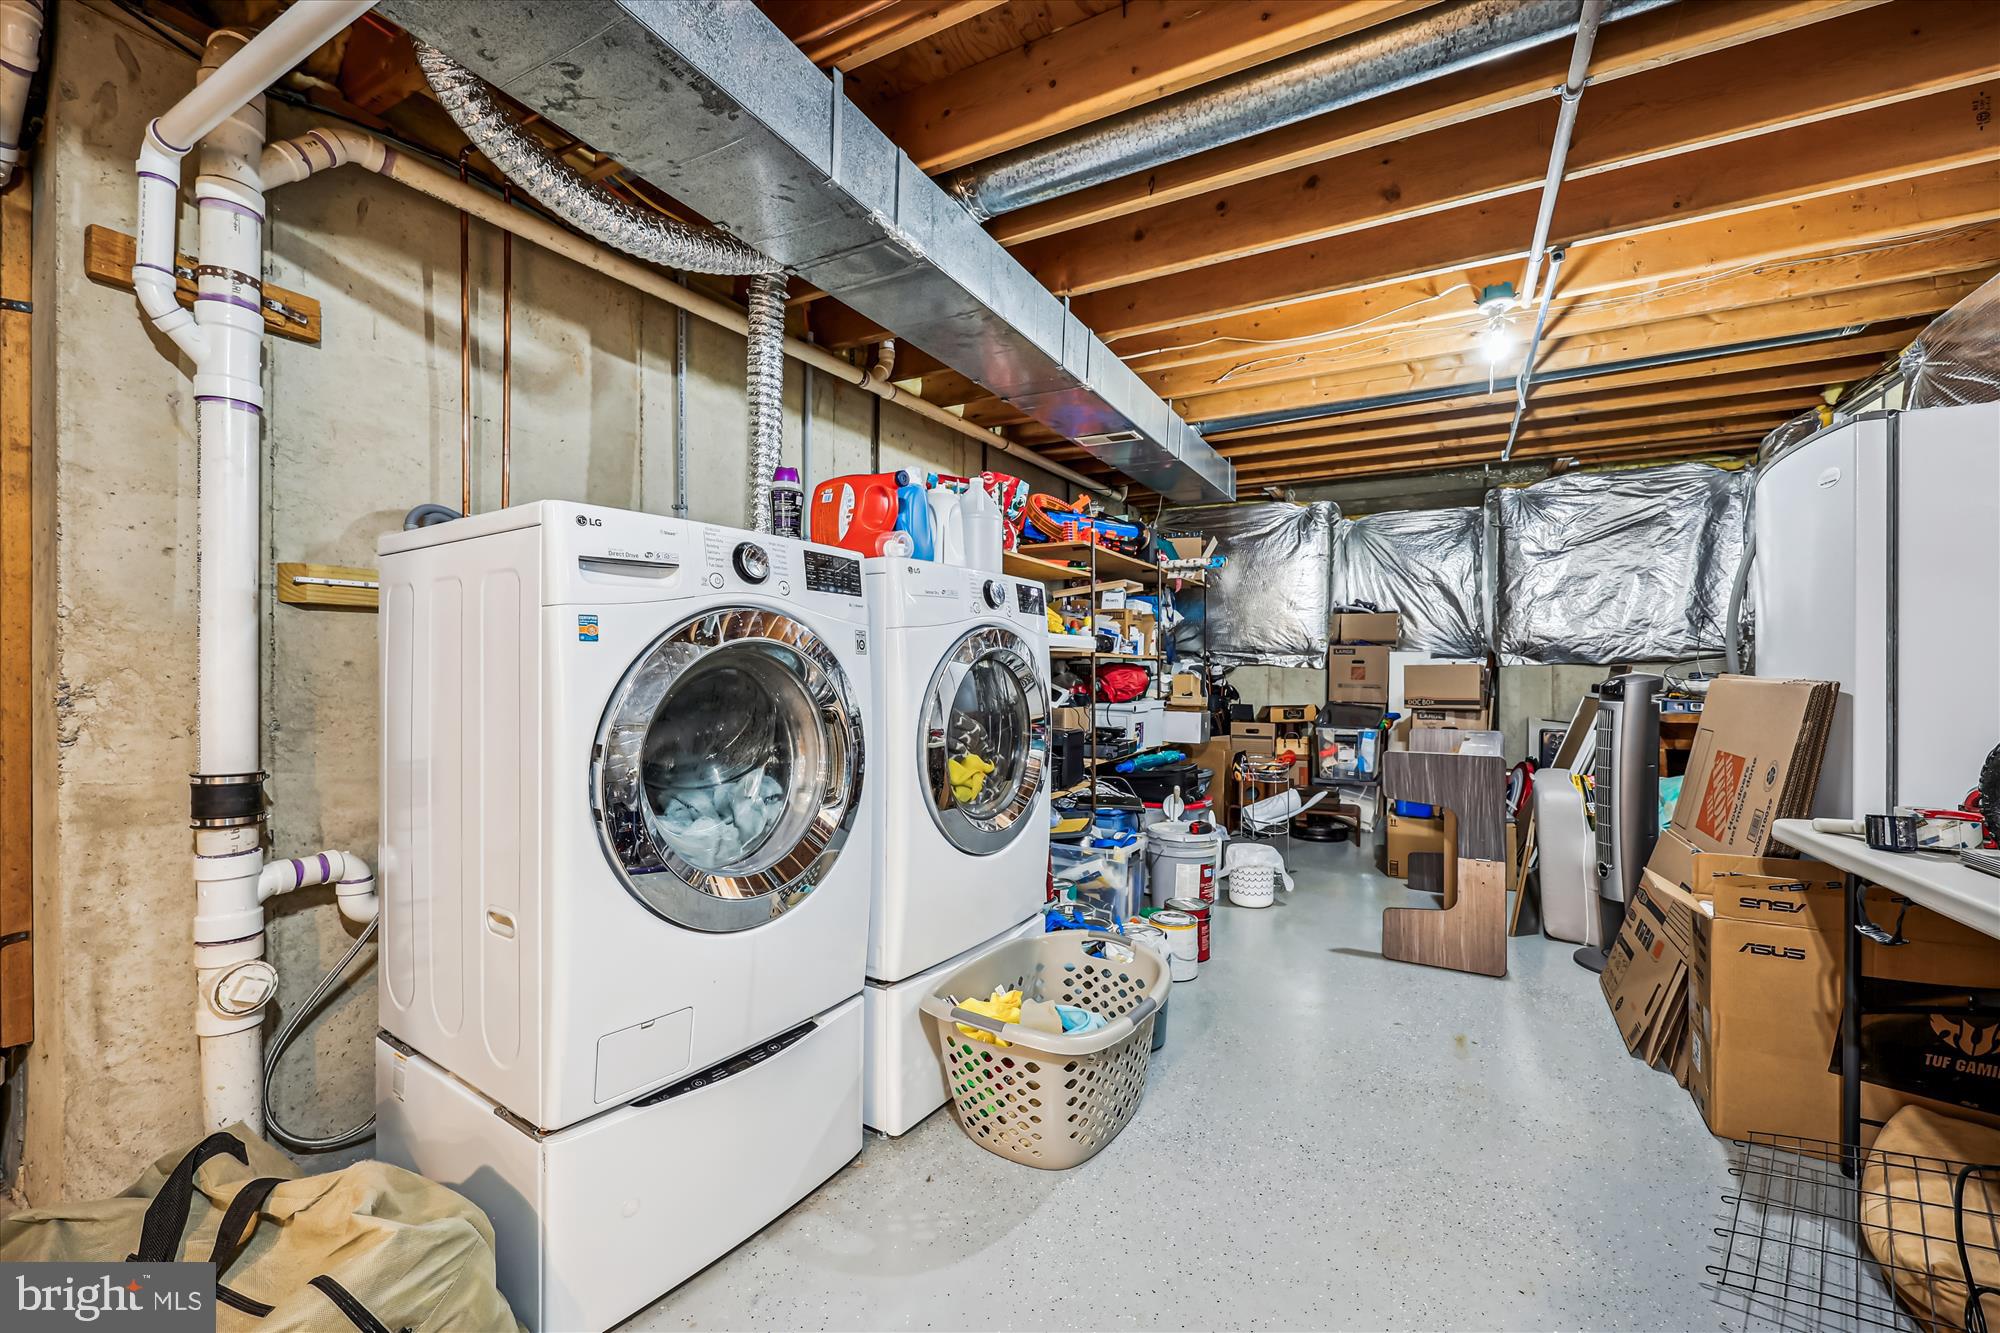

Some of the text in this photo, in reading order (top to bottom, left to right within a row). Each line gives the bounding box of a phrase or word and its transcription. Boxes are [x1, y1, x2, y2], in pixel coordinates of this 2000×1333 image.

[589, 518, 602, 527] LG
[608, 550, 639, 559] Direct Drive
[913, 567, 921, 575] LG
[1728, 766, 1750, 830] How doers
[1728, 826, 1737, 846] get
[1736, 791, 1747, 823] more
[1739, 897, 1807, 913] ASUS
[1739, 942, 1806, 960] ASUS
[1925, 1053, 1952, 1069] TUF
